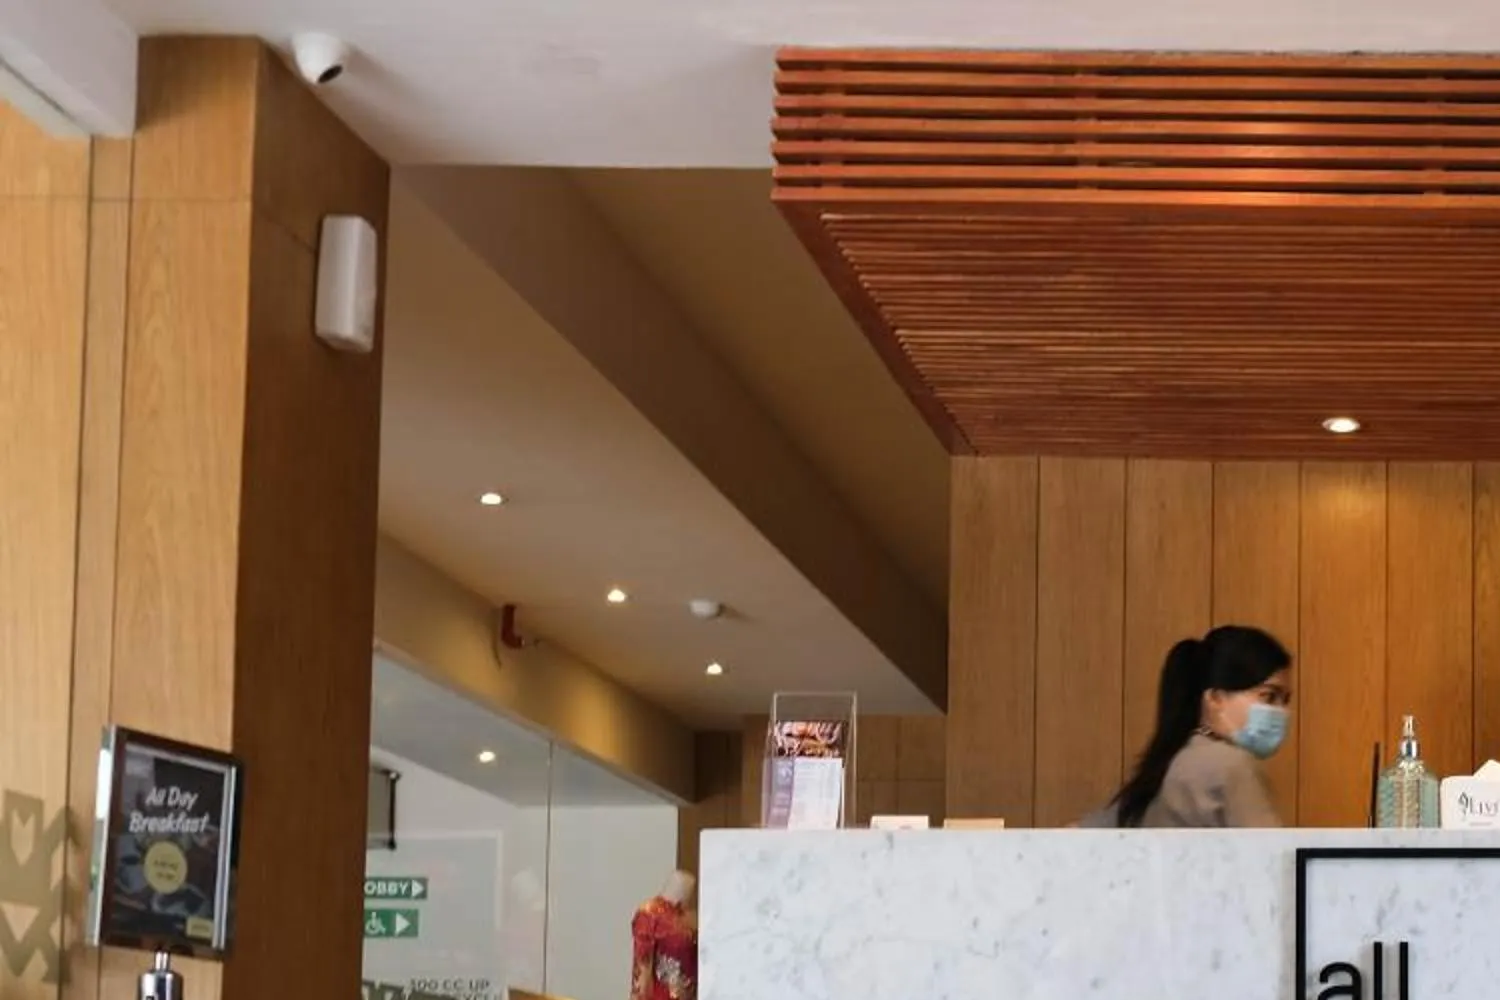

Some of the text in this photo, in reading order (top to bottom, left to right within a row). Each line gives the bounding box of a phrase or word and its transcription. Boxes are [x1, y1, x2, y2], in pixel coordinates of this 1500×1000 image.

[145, 785, 199, 812] All Day
[129, 811, 210, 833] Breakfast
[363, 880, 409, 896] OBBY
